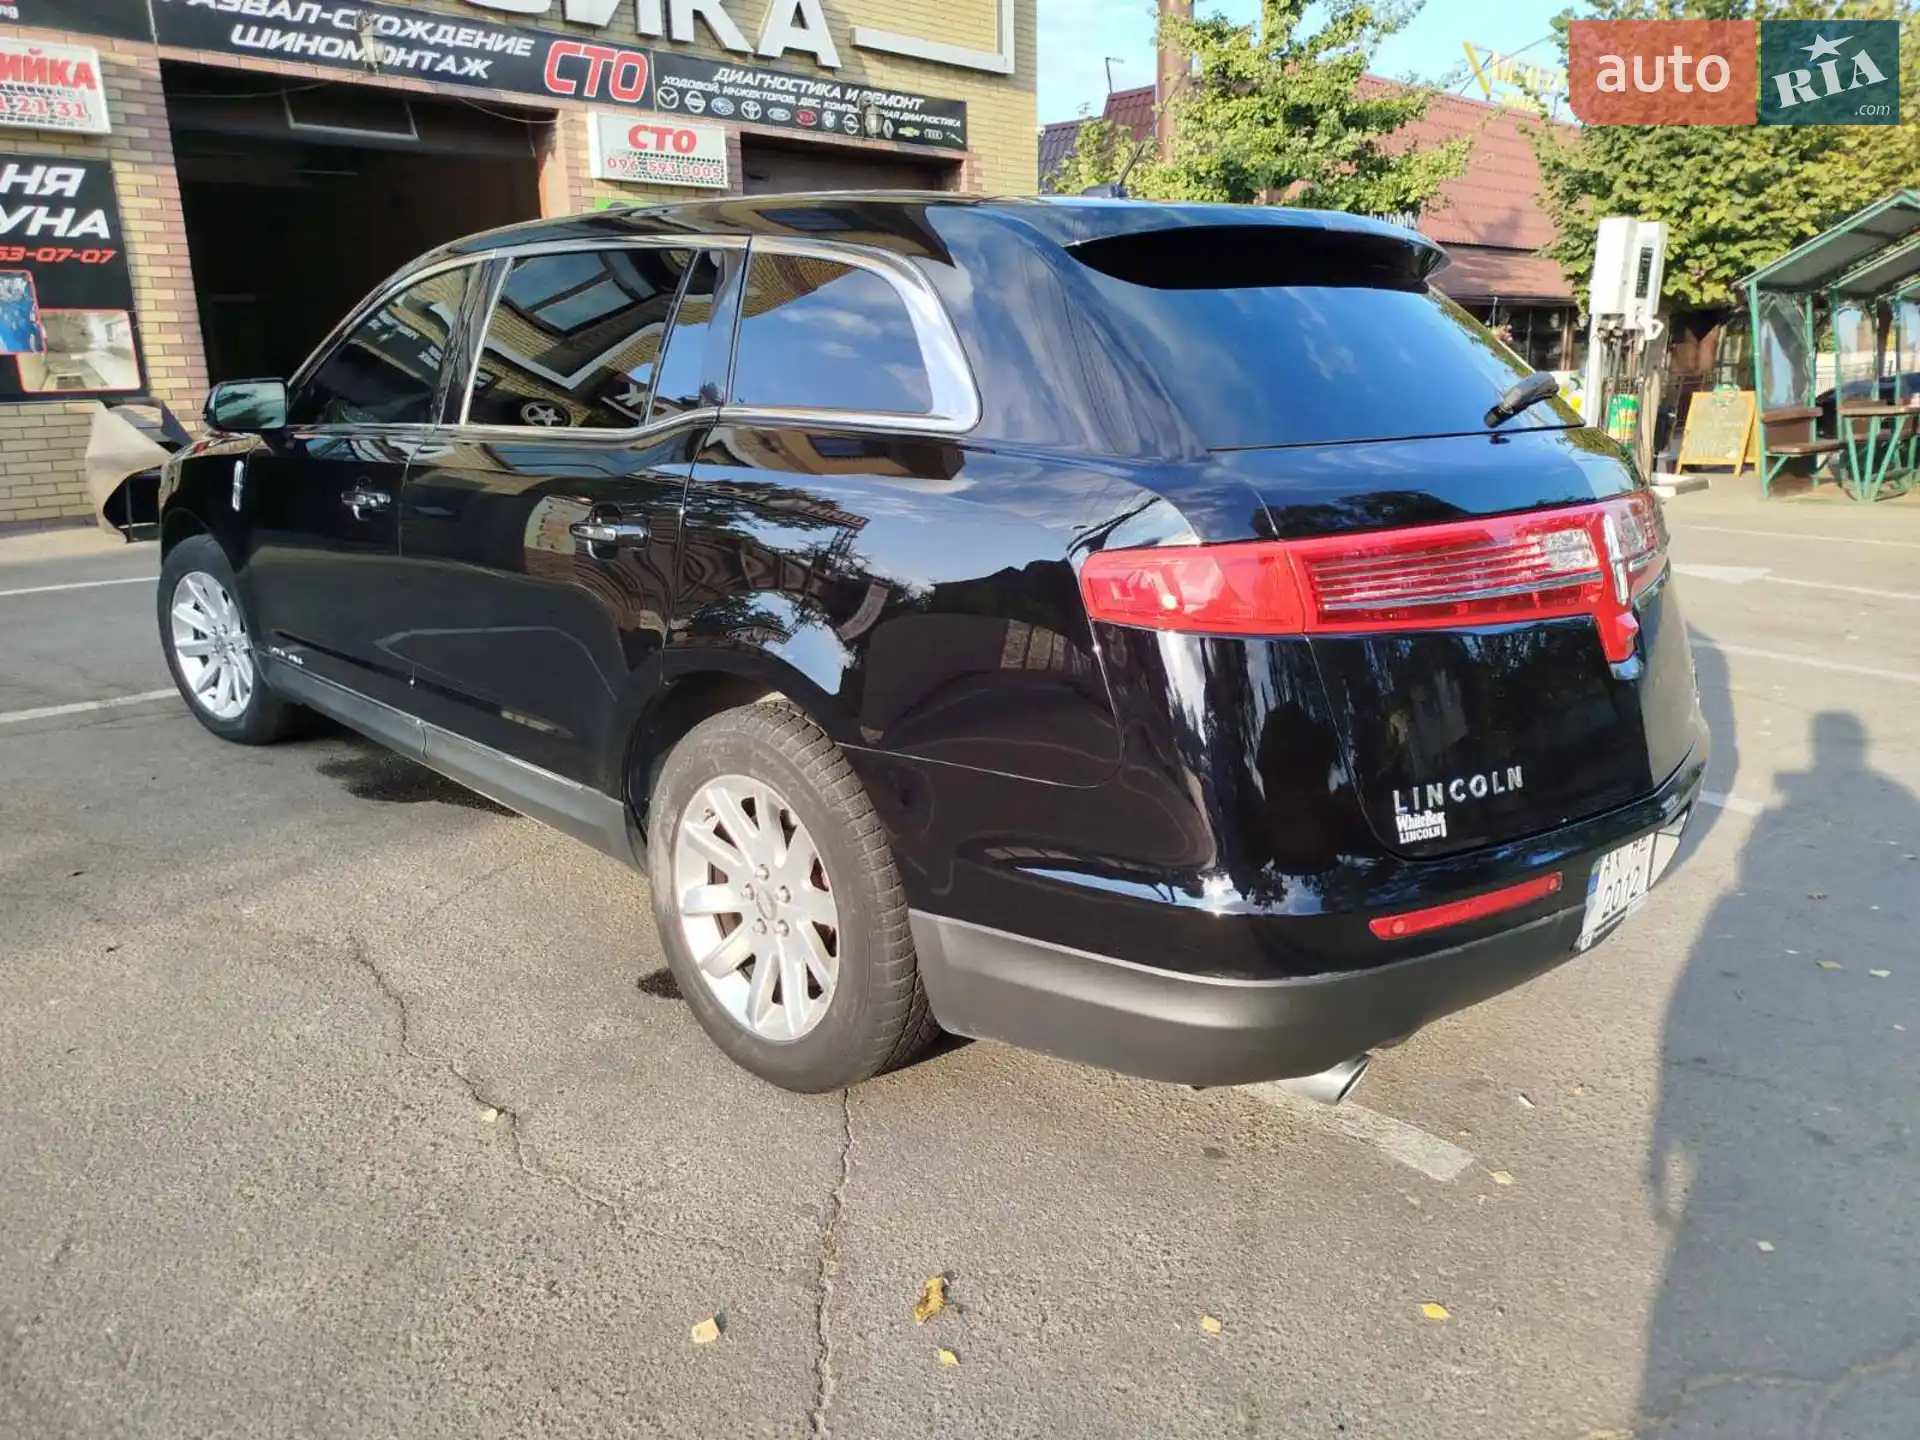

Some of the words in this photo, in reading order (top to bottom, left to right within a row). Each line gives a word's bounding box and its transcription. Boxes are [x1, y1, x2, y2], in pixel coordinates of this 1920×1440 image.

[165, 0, 535, 56] ЗВАЛ-СОЖДЕНИЕ
[544, 40, 649, 103] СТО
[712, 67, 841, 100] ДИАГНОСТИКА
[844, 87, 860, 102] И
[628, 124, 697, 154] СТО
[1392, 765, 1523, 816] LINCOLN
[1601, 866, 1640, 920] 2012
